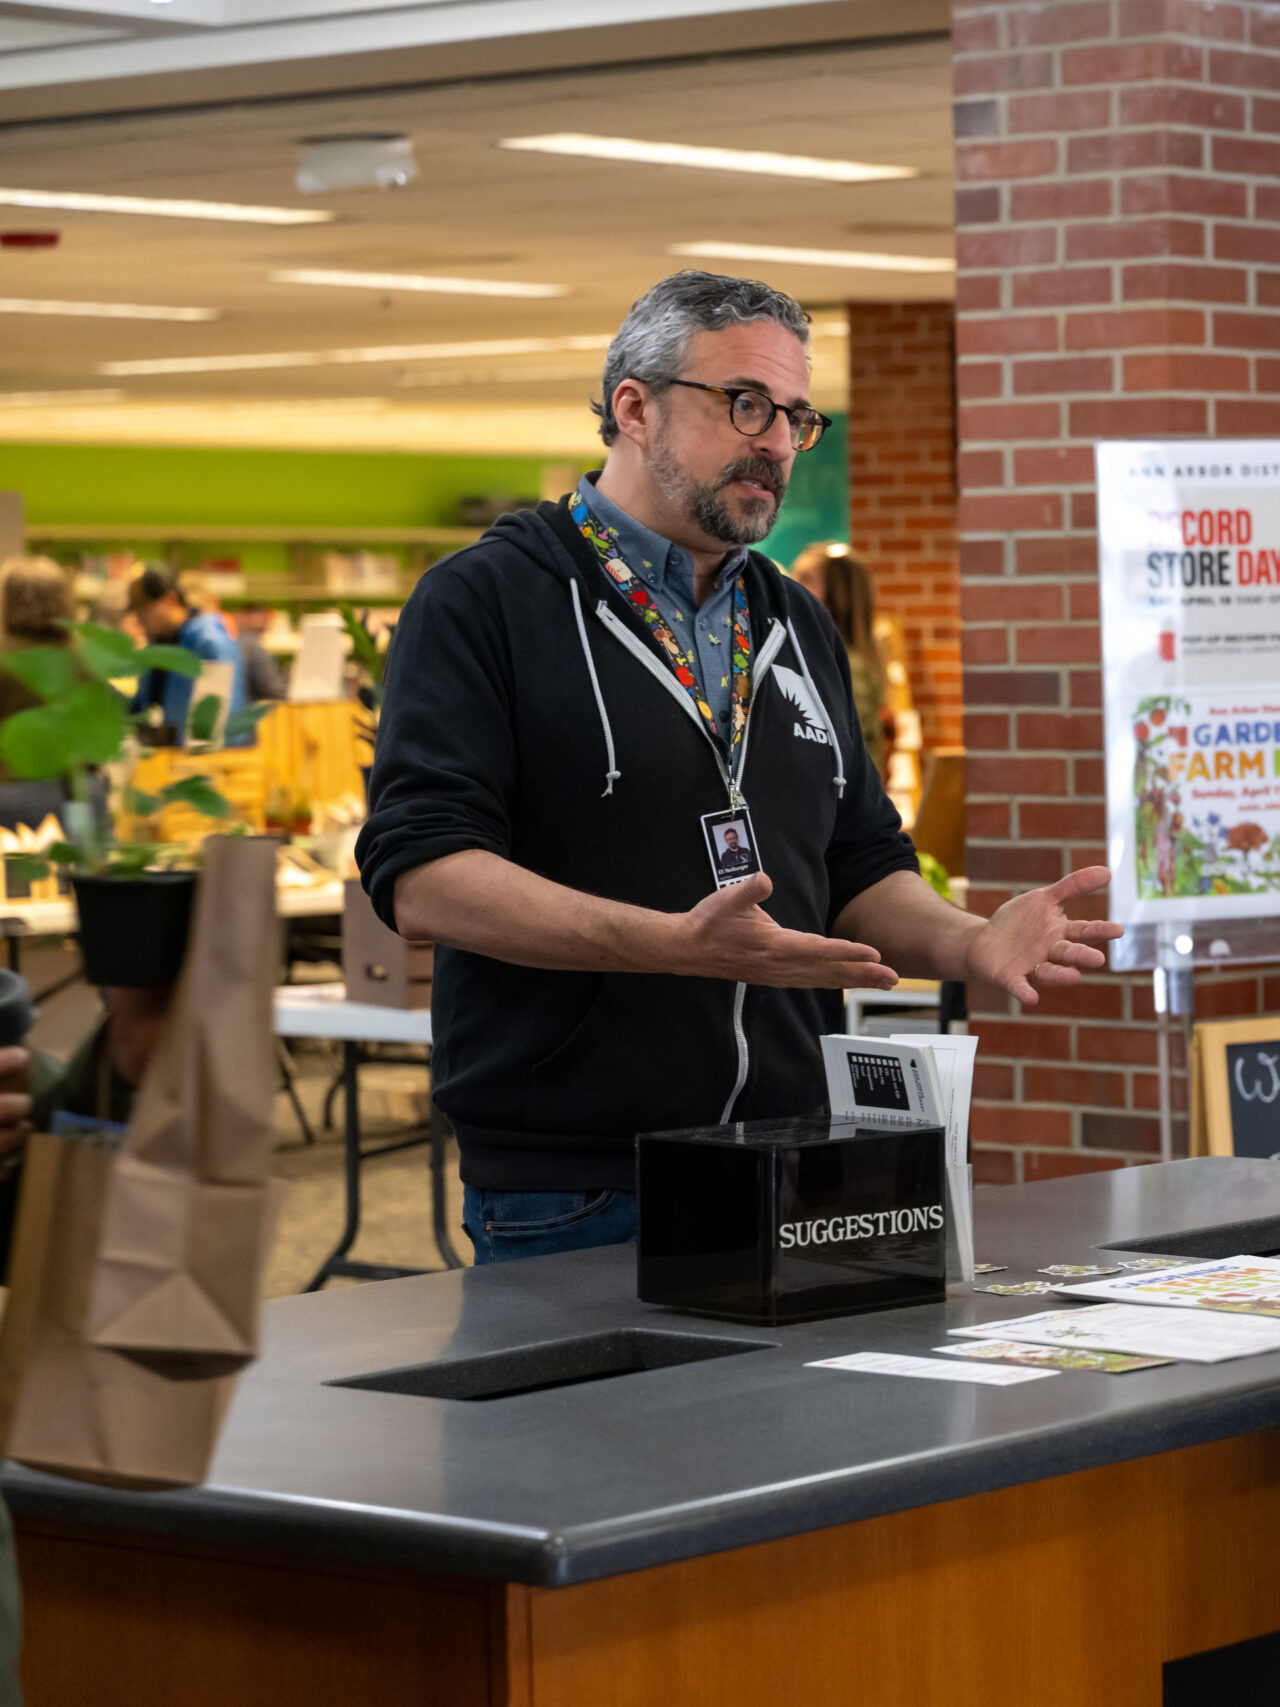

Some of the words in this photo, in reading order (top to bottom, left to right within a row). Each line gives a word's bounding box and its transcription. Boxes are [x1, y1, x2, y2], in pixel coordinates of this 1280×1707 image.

[1174, 463, 1233, 478] ARBOR
[1147, 509, 1252, 547] CORD
[1147, 549, 1231, 589] STORE
[1167, 750, 1265, 782] FARM
[779, 1205, 944, 1249] SUGGESTIONS
